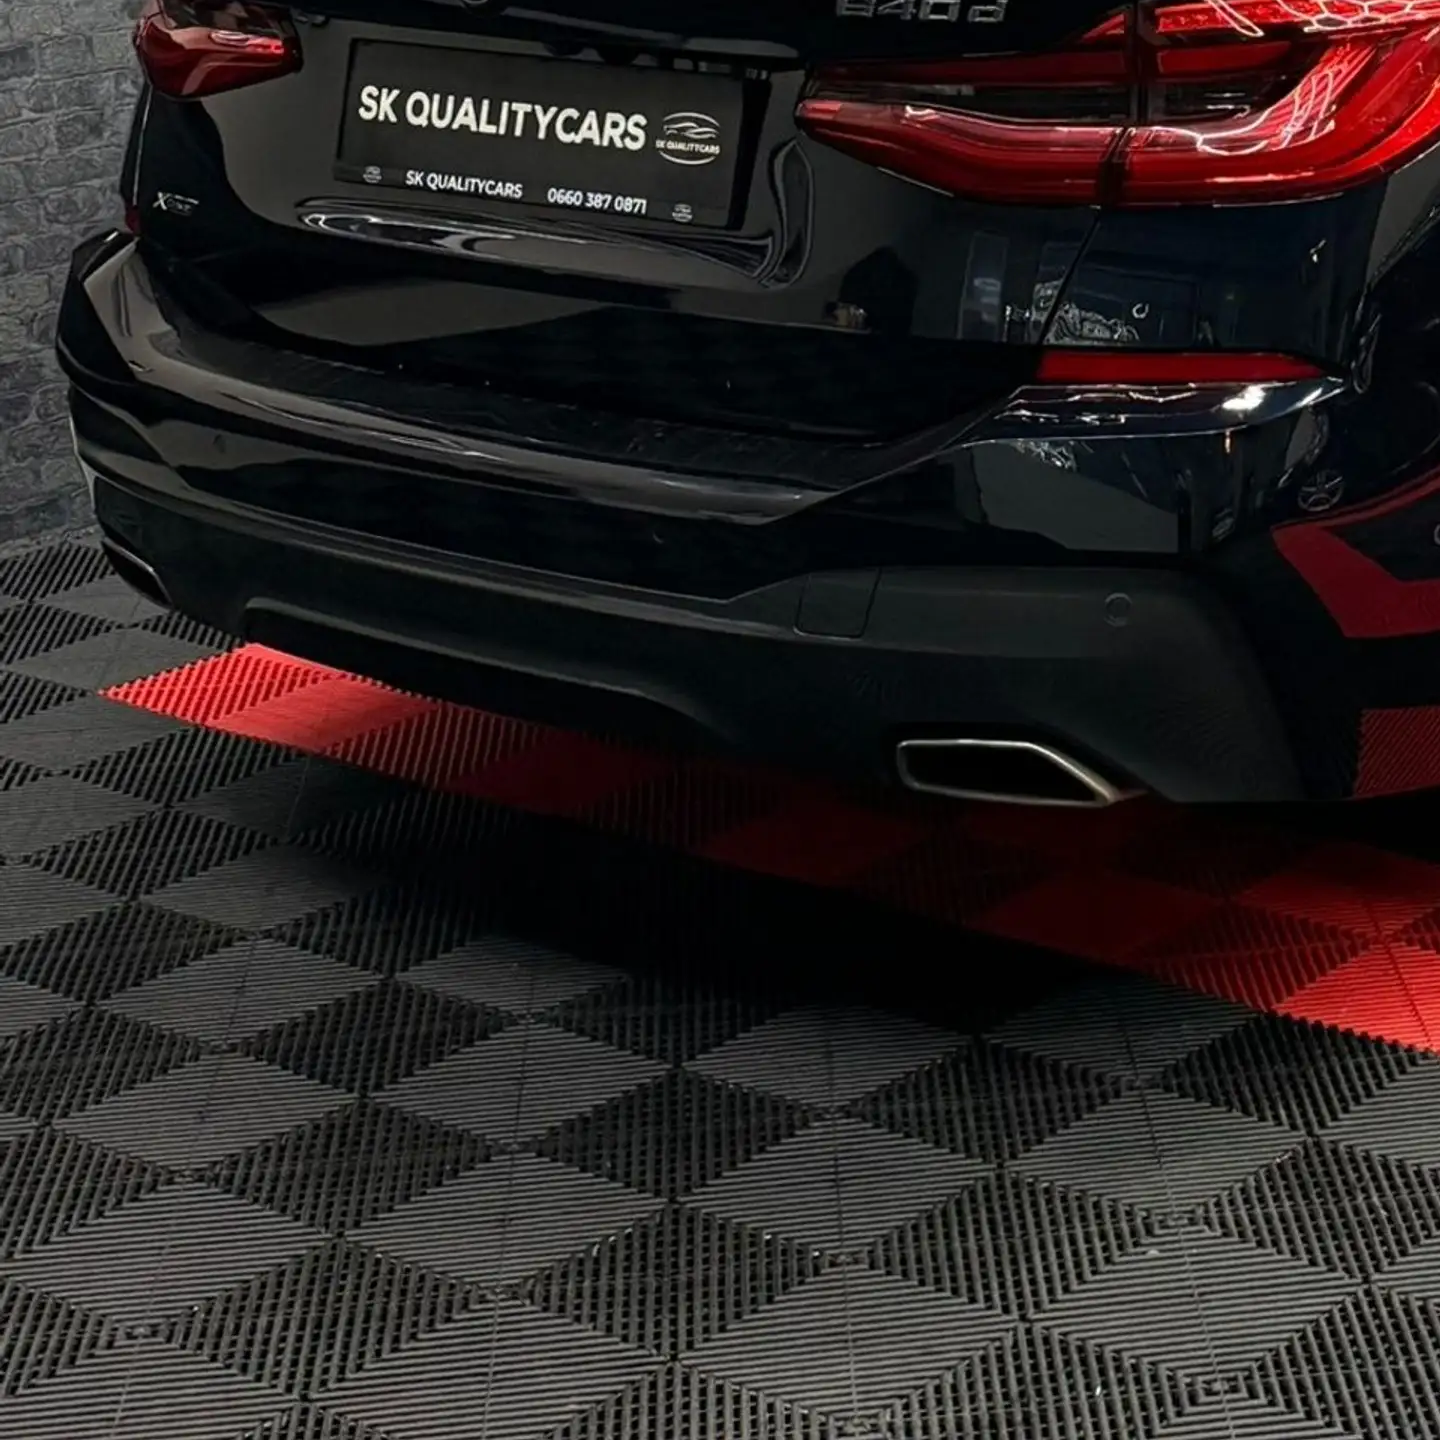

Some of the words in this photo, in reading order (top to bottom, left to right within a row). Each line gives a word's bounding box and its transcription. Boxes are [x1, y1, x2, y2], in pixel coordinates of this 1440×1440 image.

[358, 85, 400, 123] SK
[405, 91, 648, 151] QUALITYCARS
[405, 169, 424, 187] SK
[426, 172, 523, 199] QUALITYCARS
[547, 187, 583, 206] 0660
[585, 191, 612, 210] 387
[614, 195, 648, 215] 0871
